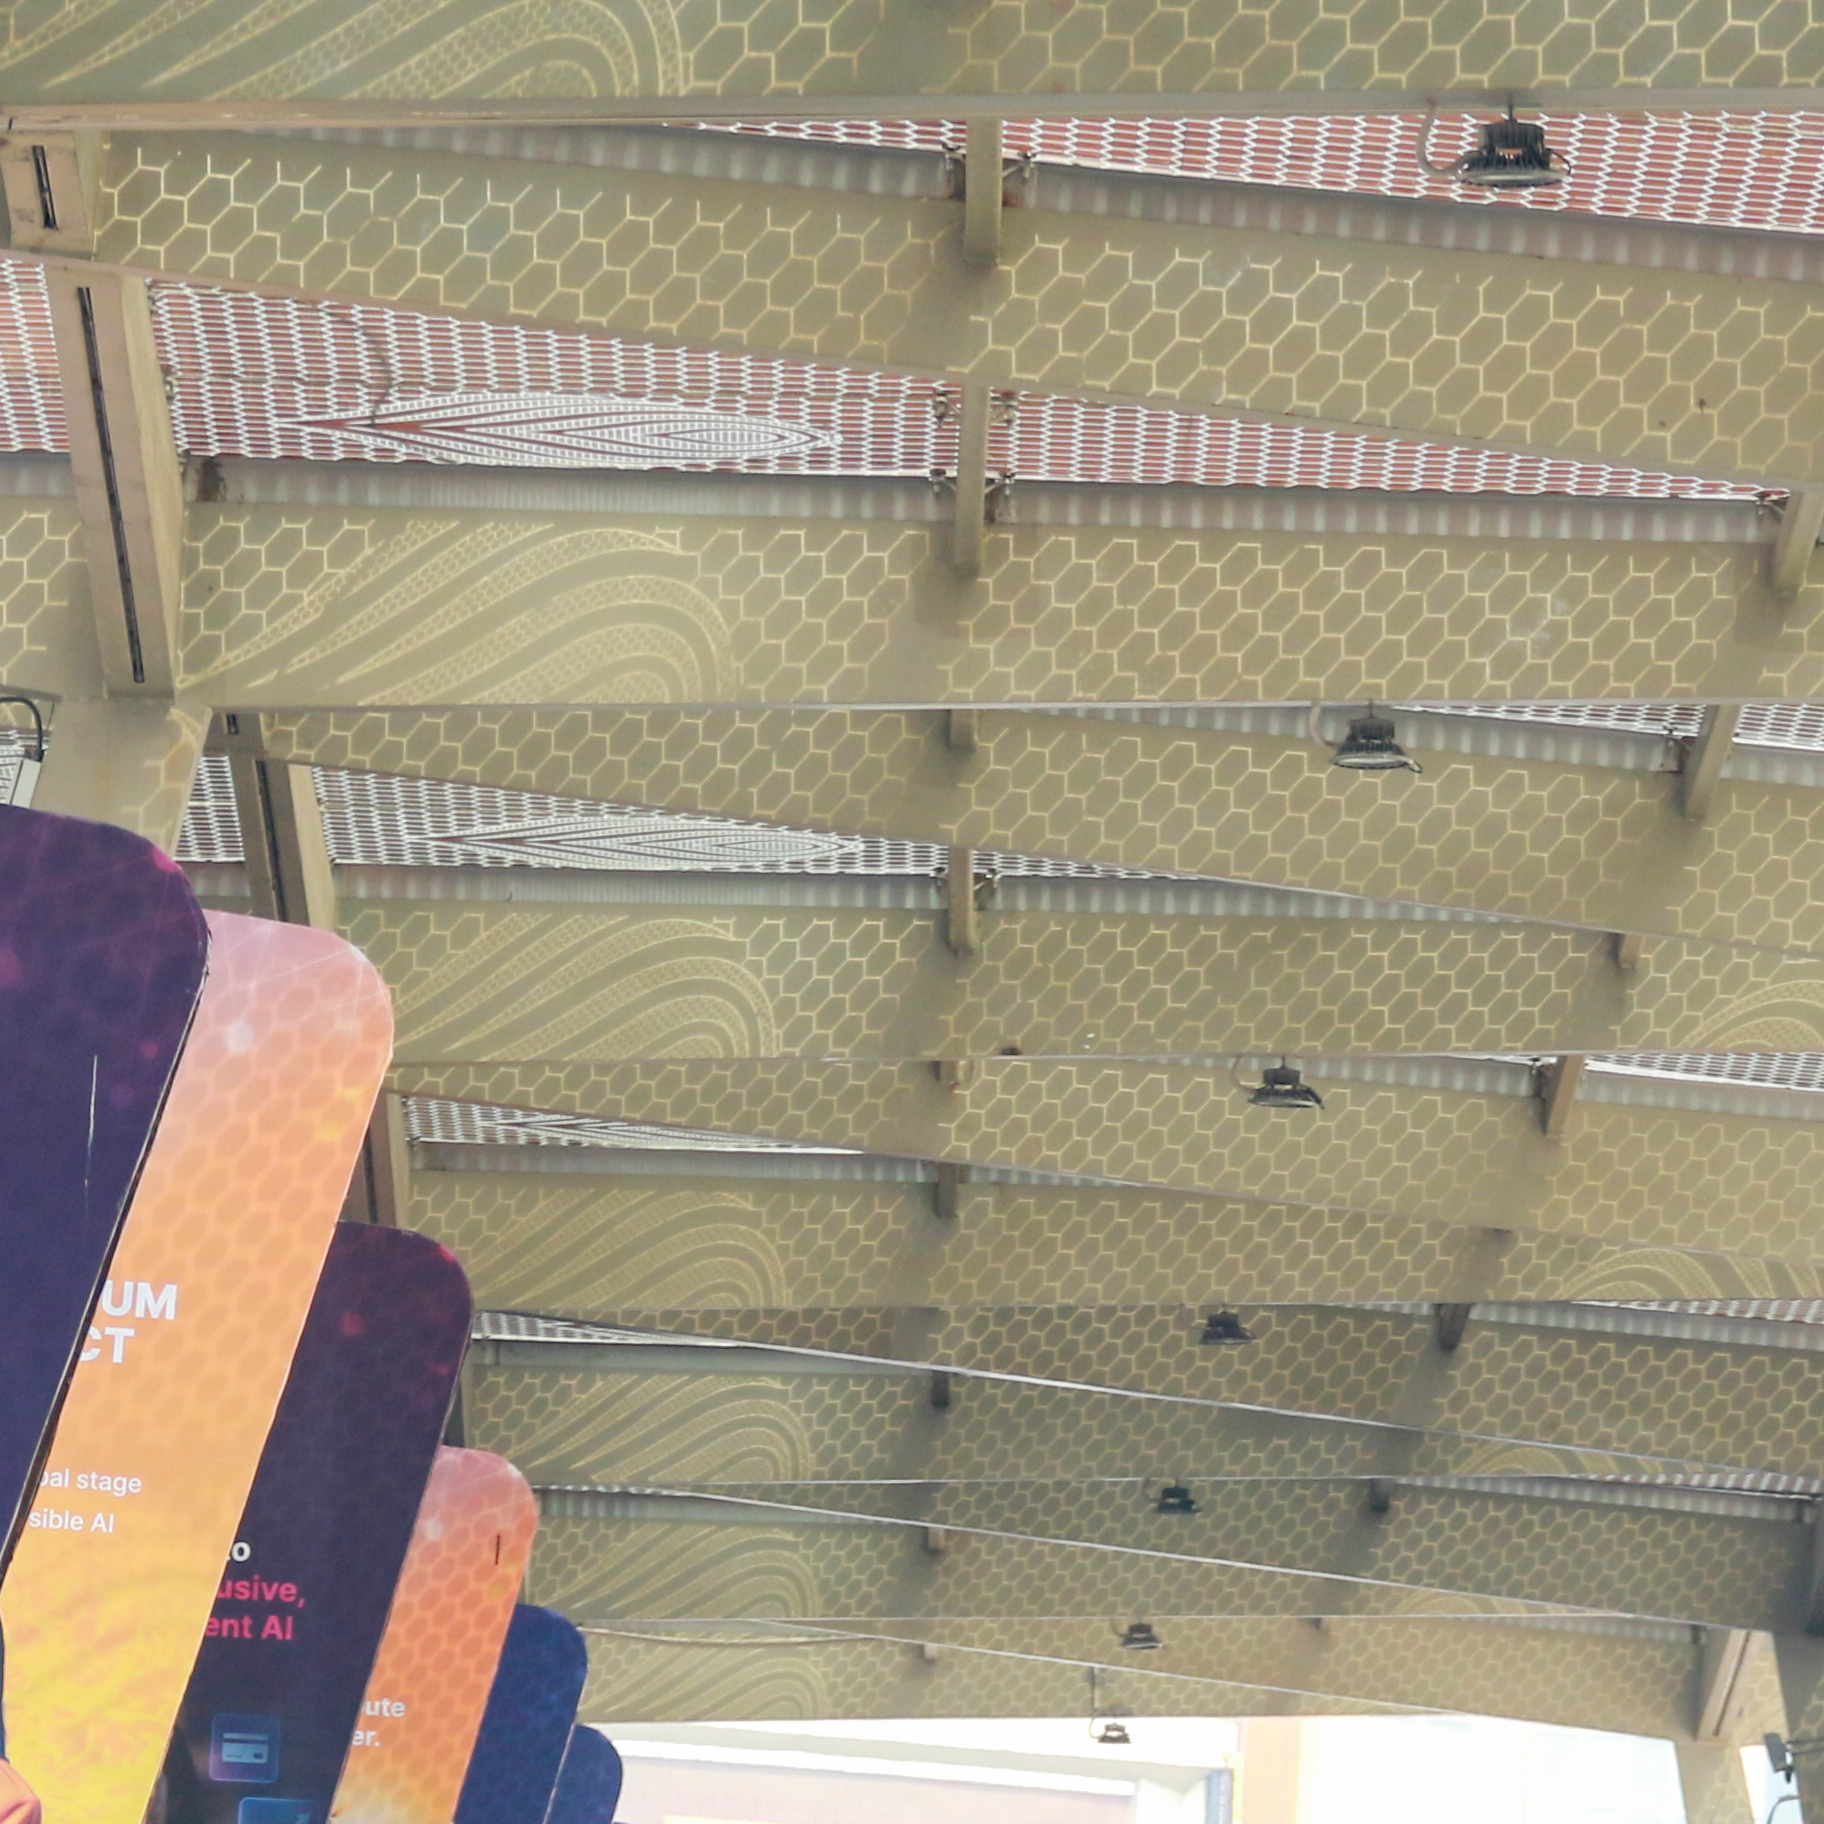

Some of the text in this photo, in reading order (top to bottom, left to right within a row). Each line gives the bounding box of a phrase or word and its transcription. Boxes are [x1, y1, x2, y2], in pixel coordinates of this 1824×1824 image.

[76, 1471, 142, 1497] stage
[28, 1507, 115, 1533] sible AI
[261, 1614, 294, 1640] AI
